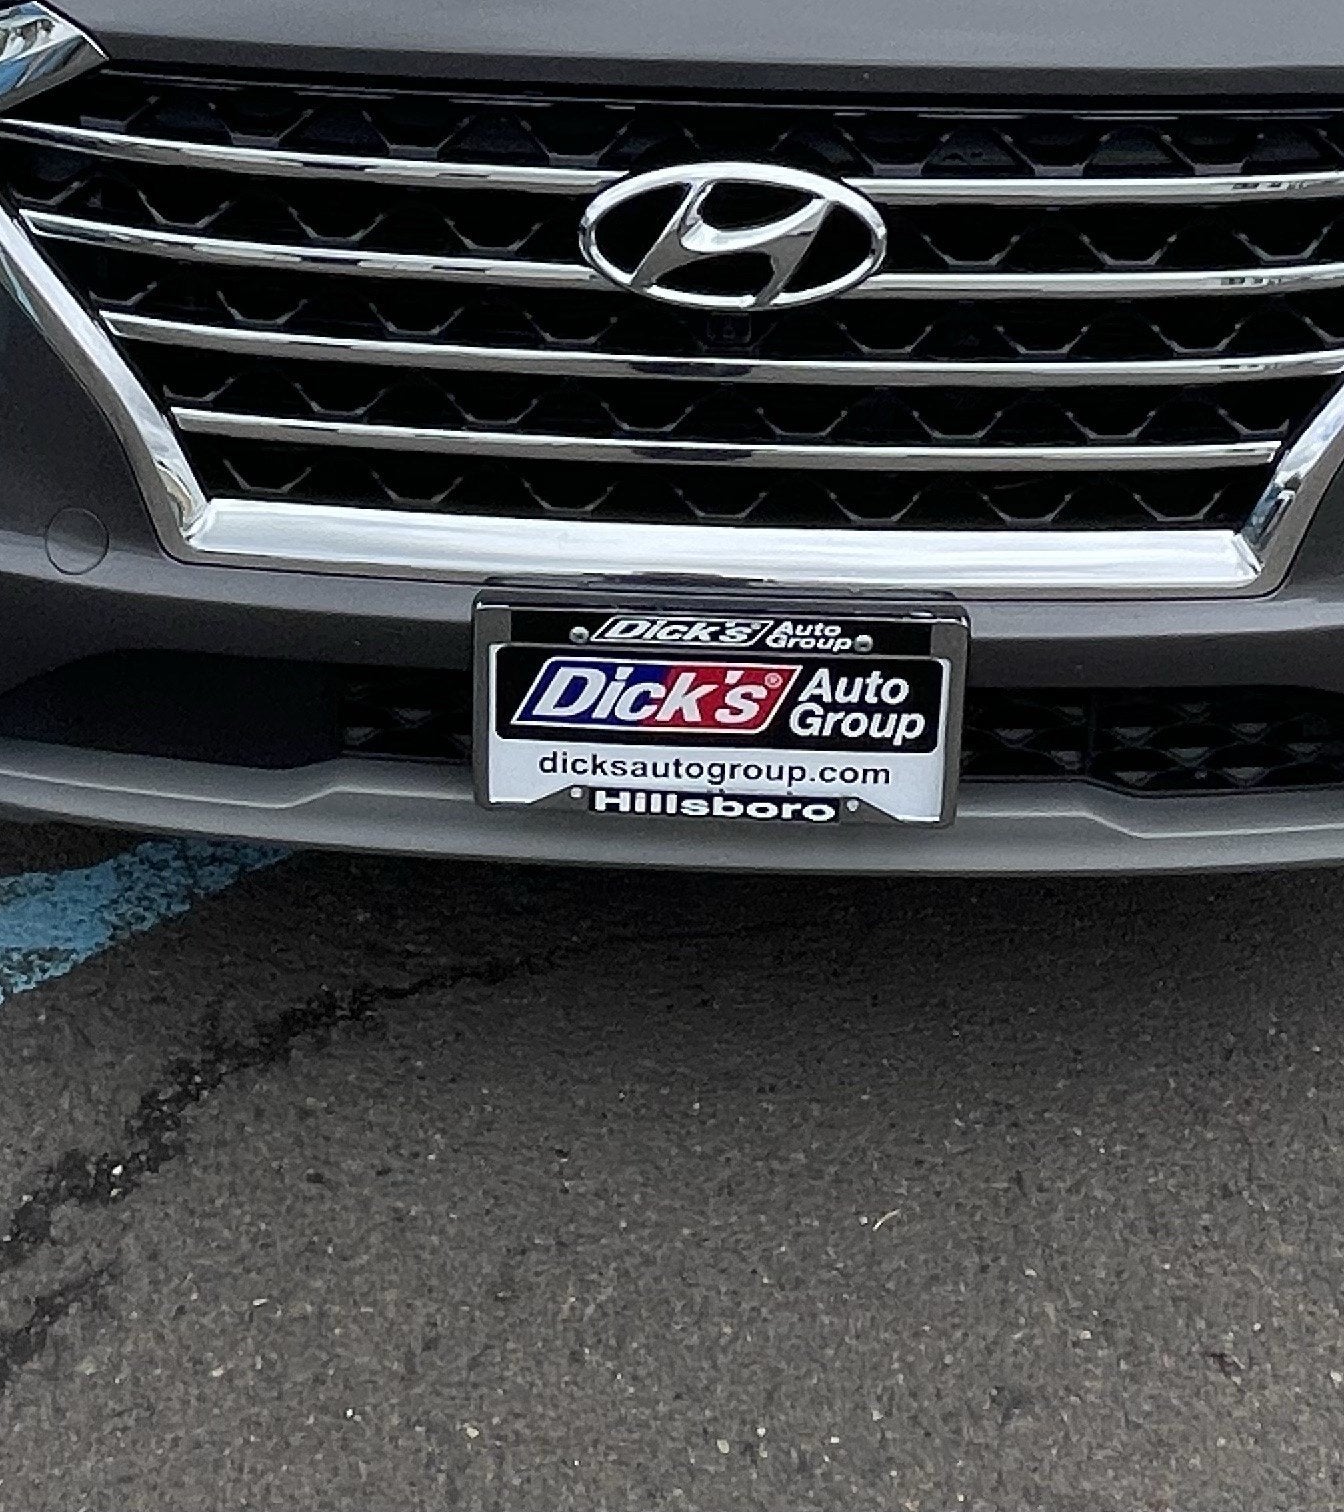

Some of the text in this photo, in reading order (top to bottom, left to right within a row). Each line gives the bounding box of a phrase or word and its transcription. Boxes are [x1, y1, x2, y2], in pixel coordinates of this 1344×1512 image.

[765, 635, 852, 652] Group
[771, 620, 842, 637] Auto
[798, 667, 910, 705] Auto
[788, 701, 926, 745] Group
[538, 751, 891, 786] dicksautogroup.com
[594, 790, 837, 822] Hillsboro
